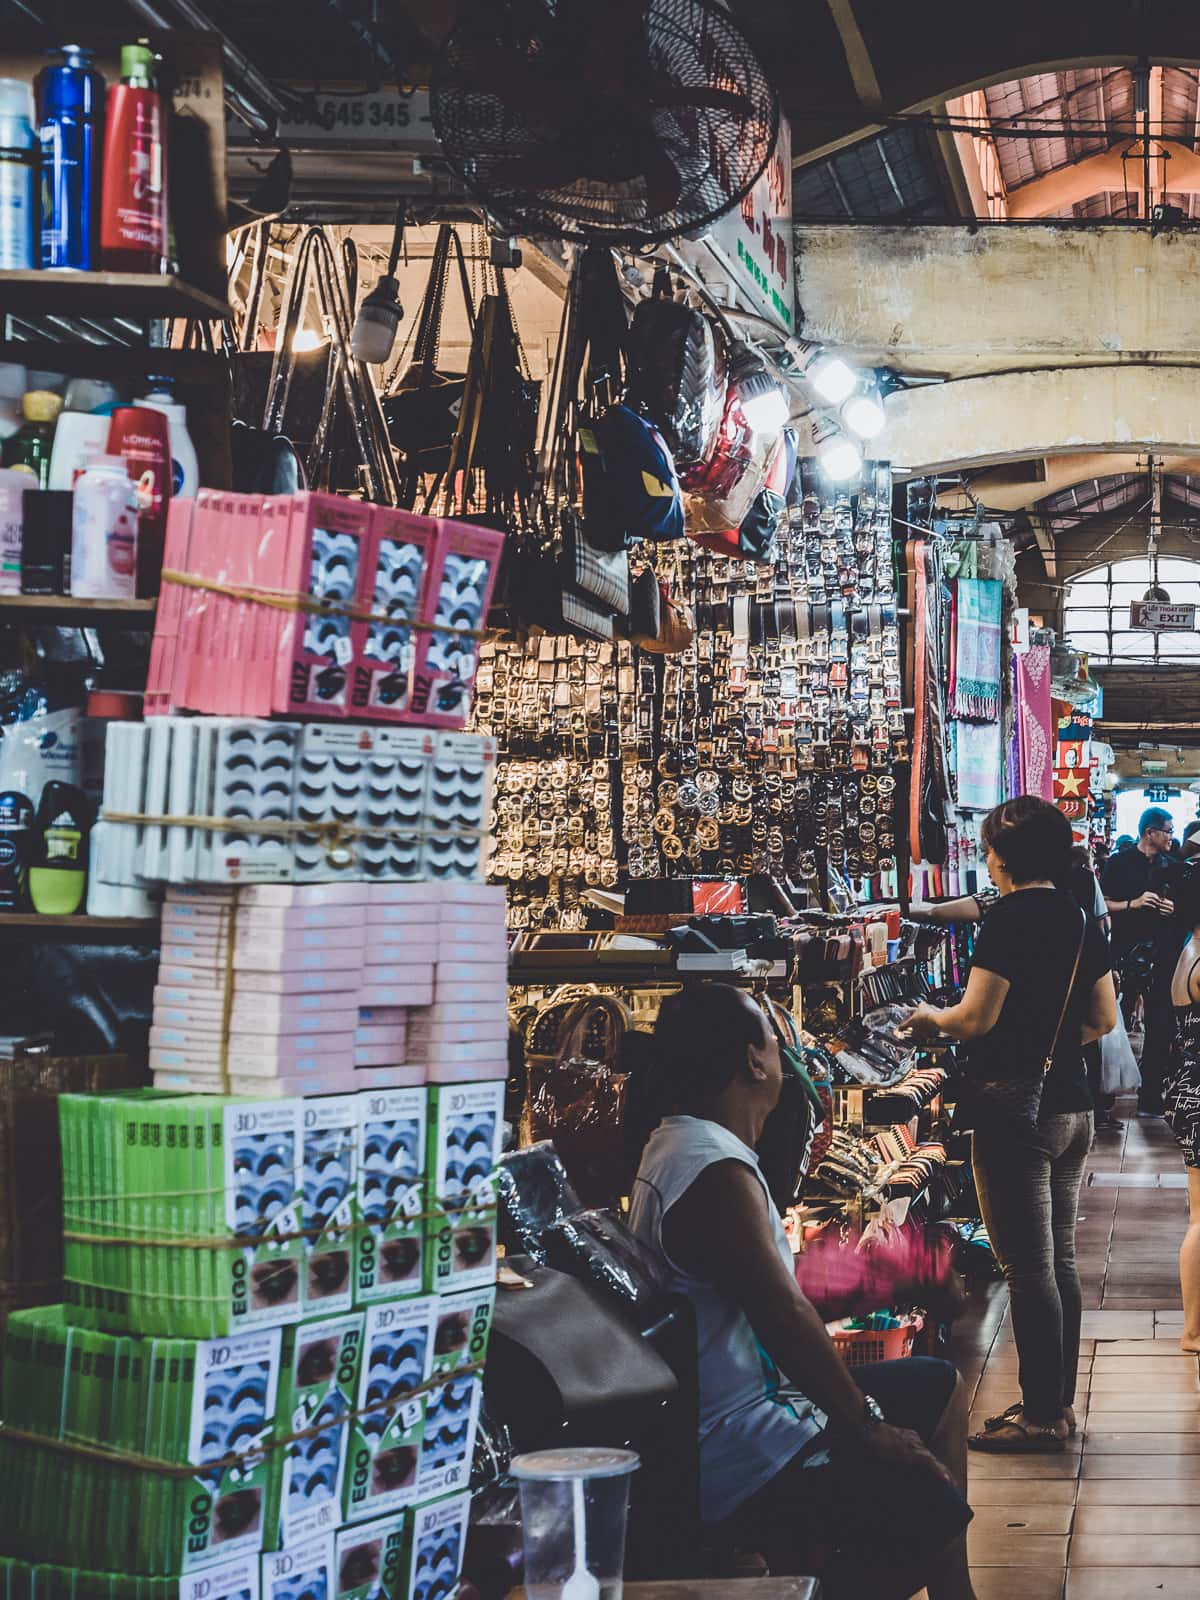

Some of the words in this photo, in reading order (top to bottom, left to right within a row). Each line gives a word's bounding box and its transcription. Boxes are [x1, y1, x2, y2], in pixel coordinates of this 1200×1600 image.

[369, 101, 411, 127] 345
[1159, 614, 1189, 623] EXIT
[359, 1235, 376, 1289] EGO
[438, 1226, 454, 1278] EGO
[231, 1258, 248, 1317] EGO
[469, 1303, 490, 1355] EGO
[337, 1329, 360, 1384] EGO
[352, 1448, 371, 1503] EGO
[188, 1493, 213, 1553] EGO
[382, 1530, 402, 1585] EGO
